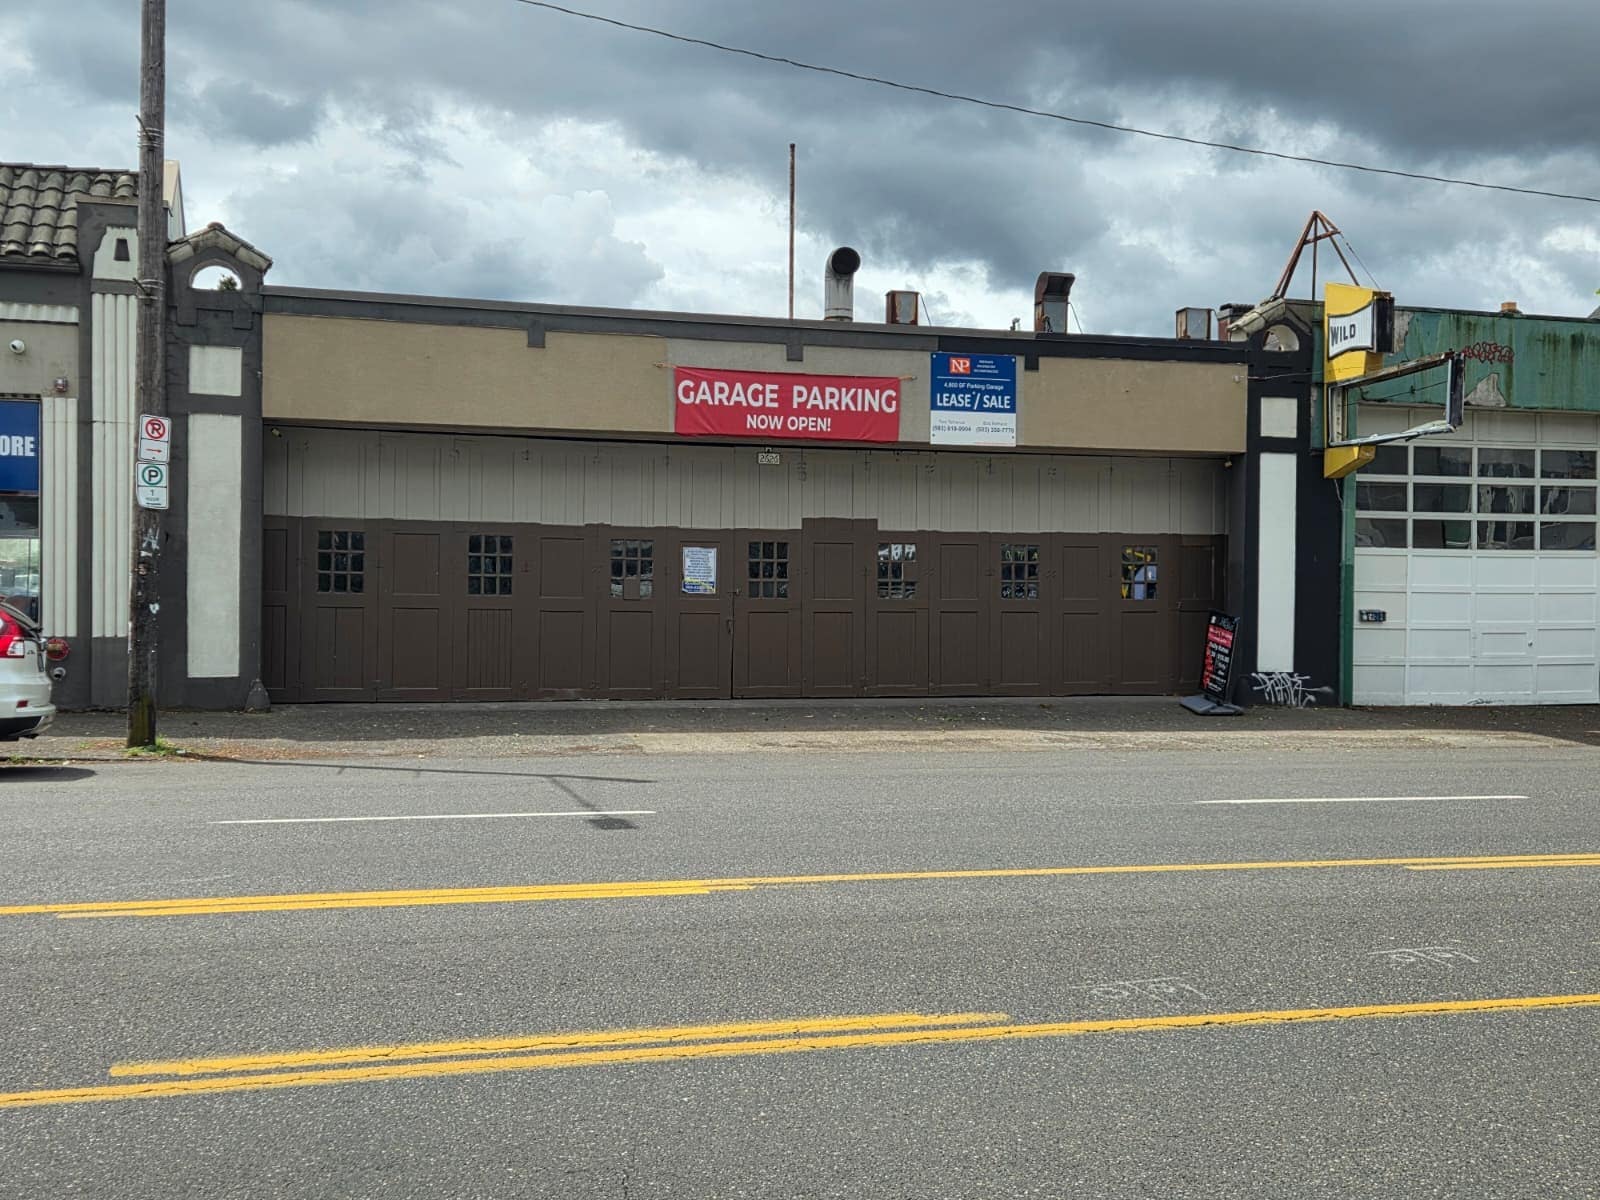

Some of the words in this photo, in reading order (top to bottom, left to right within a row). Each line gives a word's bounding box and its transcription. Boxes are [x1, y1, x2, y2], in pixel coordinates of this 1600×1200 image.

[1330, 323, 1356, 346] WILD
[951, 358, 970, 373] NP
[966, 382, 986, 390] Parking
[677, 379, 779, 408] GARAGE
[793, 385, 897, 413] PARKING
[937, 393, 971, 407] LEASE
[974, 393, 981, 410] /
[983, 395, 1010, 408] SALE
[746, 414, 784, 430] NOW
[787, 416, 831, 432] OPEN!
[0, 434, 35, 457] ORE
